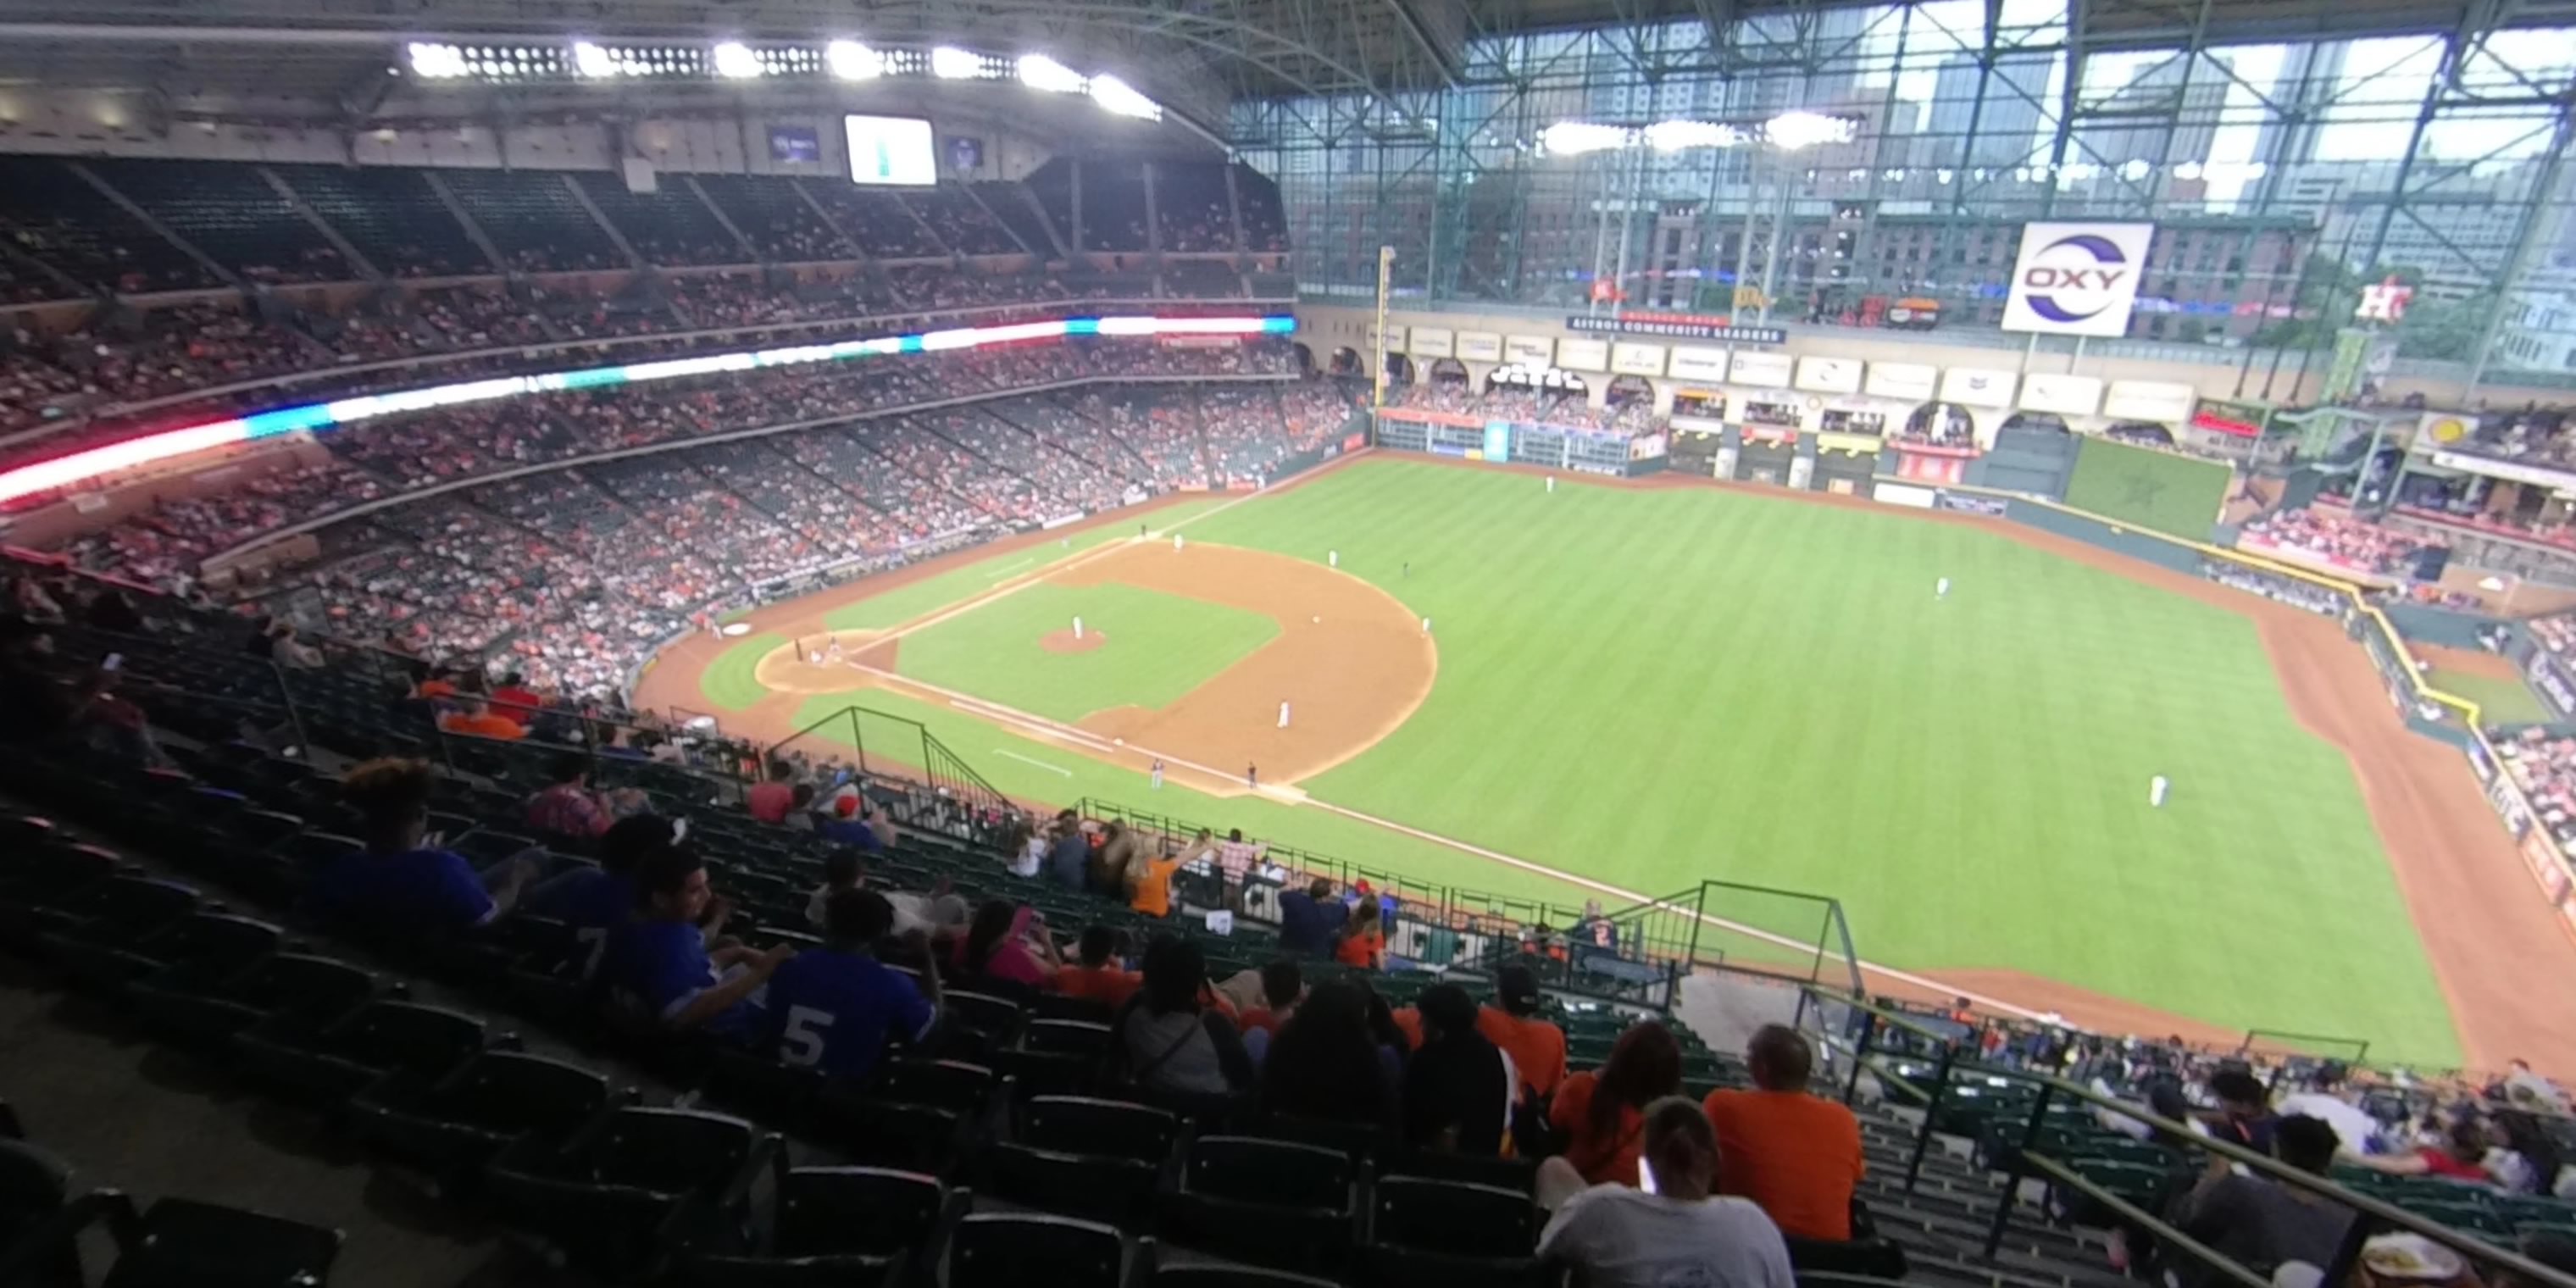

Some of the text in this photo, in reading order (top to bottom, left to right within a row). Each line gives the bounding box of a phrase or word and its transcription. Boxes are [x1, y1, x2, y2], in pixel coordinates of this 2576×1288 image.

[2024, 267, 2125, 291] OXY
[1573, 318, 1620, 330] ASTROS
[1624, 322, 1710, 337] COMMUNITY
[1713, 327, 1780, 341] LEADERS
[576, 927, 608, 980] 7
[779, 1003, 836, 1067] 5
